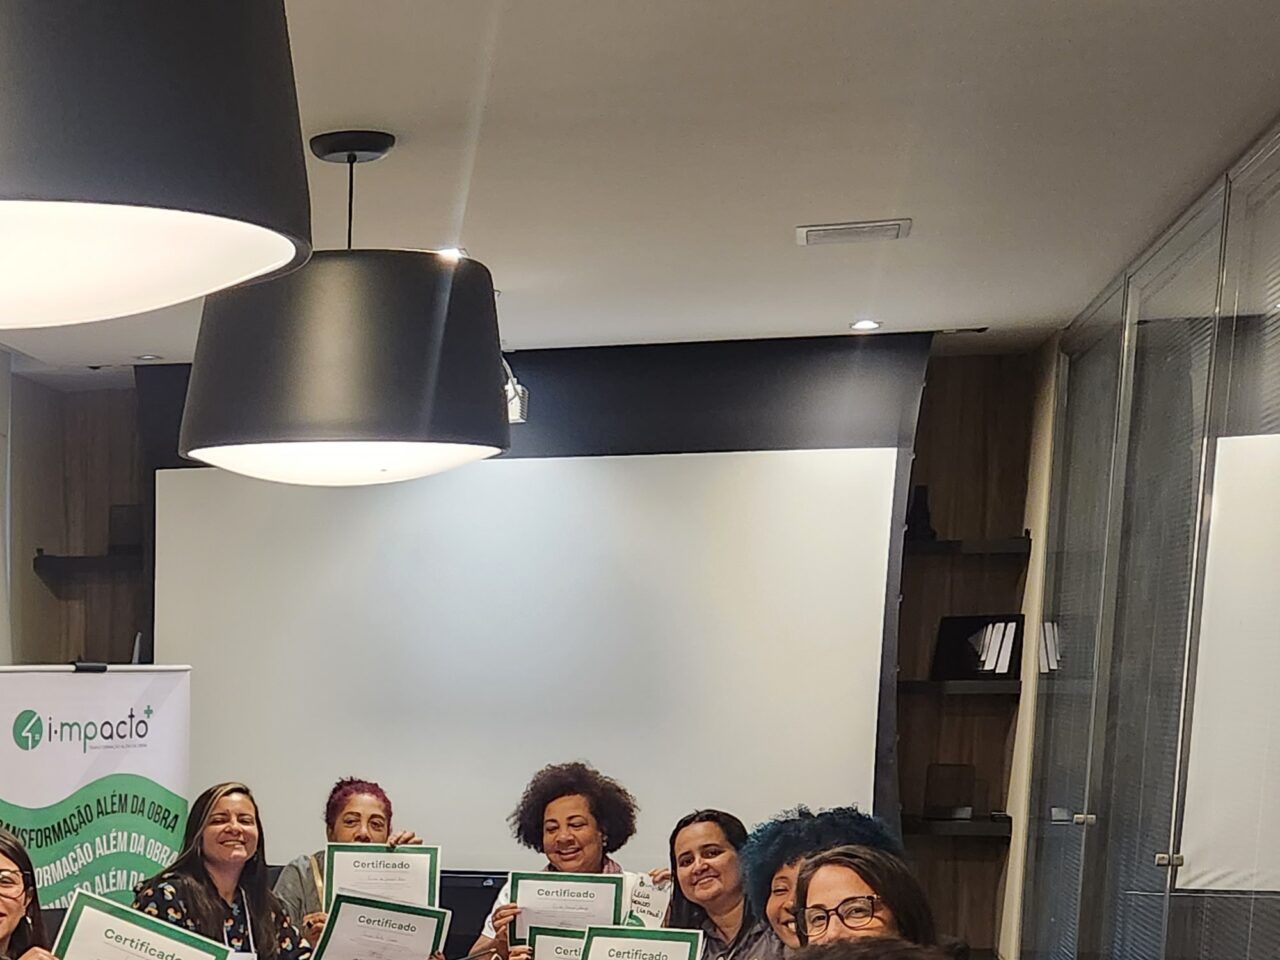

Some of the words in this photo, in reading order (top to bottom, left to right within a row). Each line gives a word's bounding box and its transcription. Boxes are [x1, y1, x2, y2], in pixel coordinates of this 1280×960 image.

[96, 790, 128, 819] ALÉM
[130, 794, 146, 817] DA
[147, 801, 180, 834] OBRA
[95, 829, 128, 858] ALÉM
[129, 832, 145, 856] DA
[145, 838, 179, 869] OBRA
[353, 860, 410, 870] Certificado
[94, 867, 128, 896] ALÉM
[537, 888, 596, 899] Certificado
[358, 915, 417, 932] Certificado
